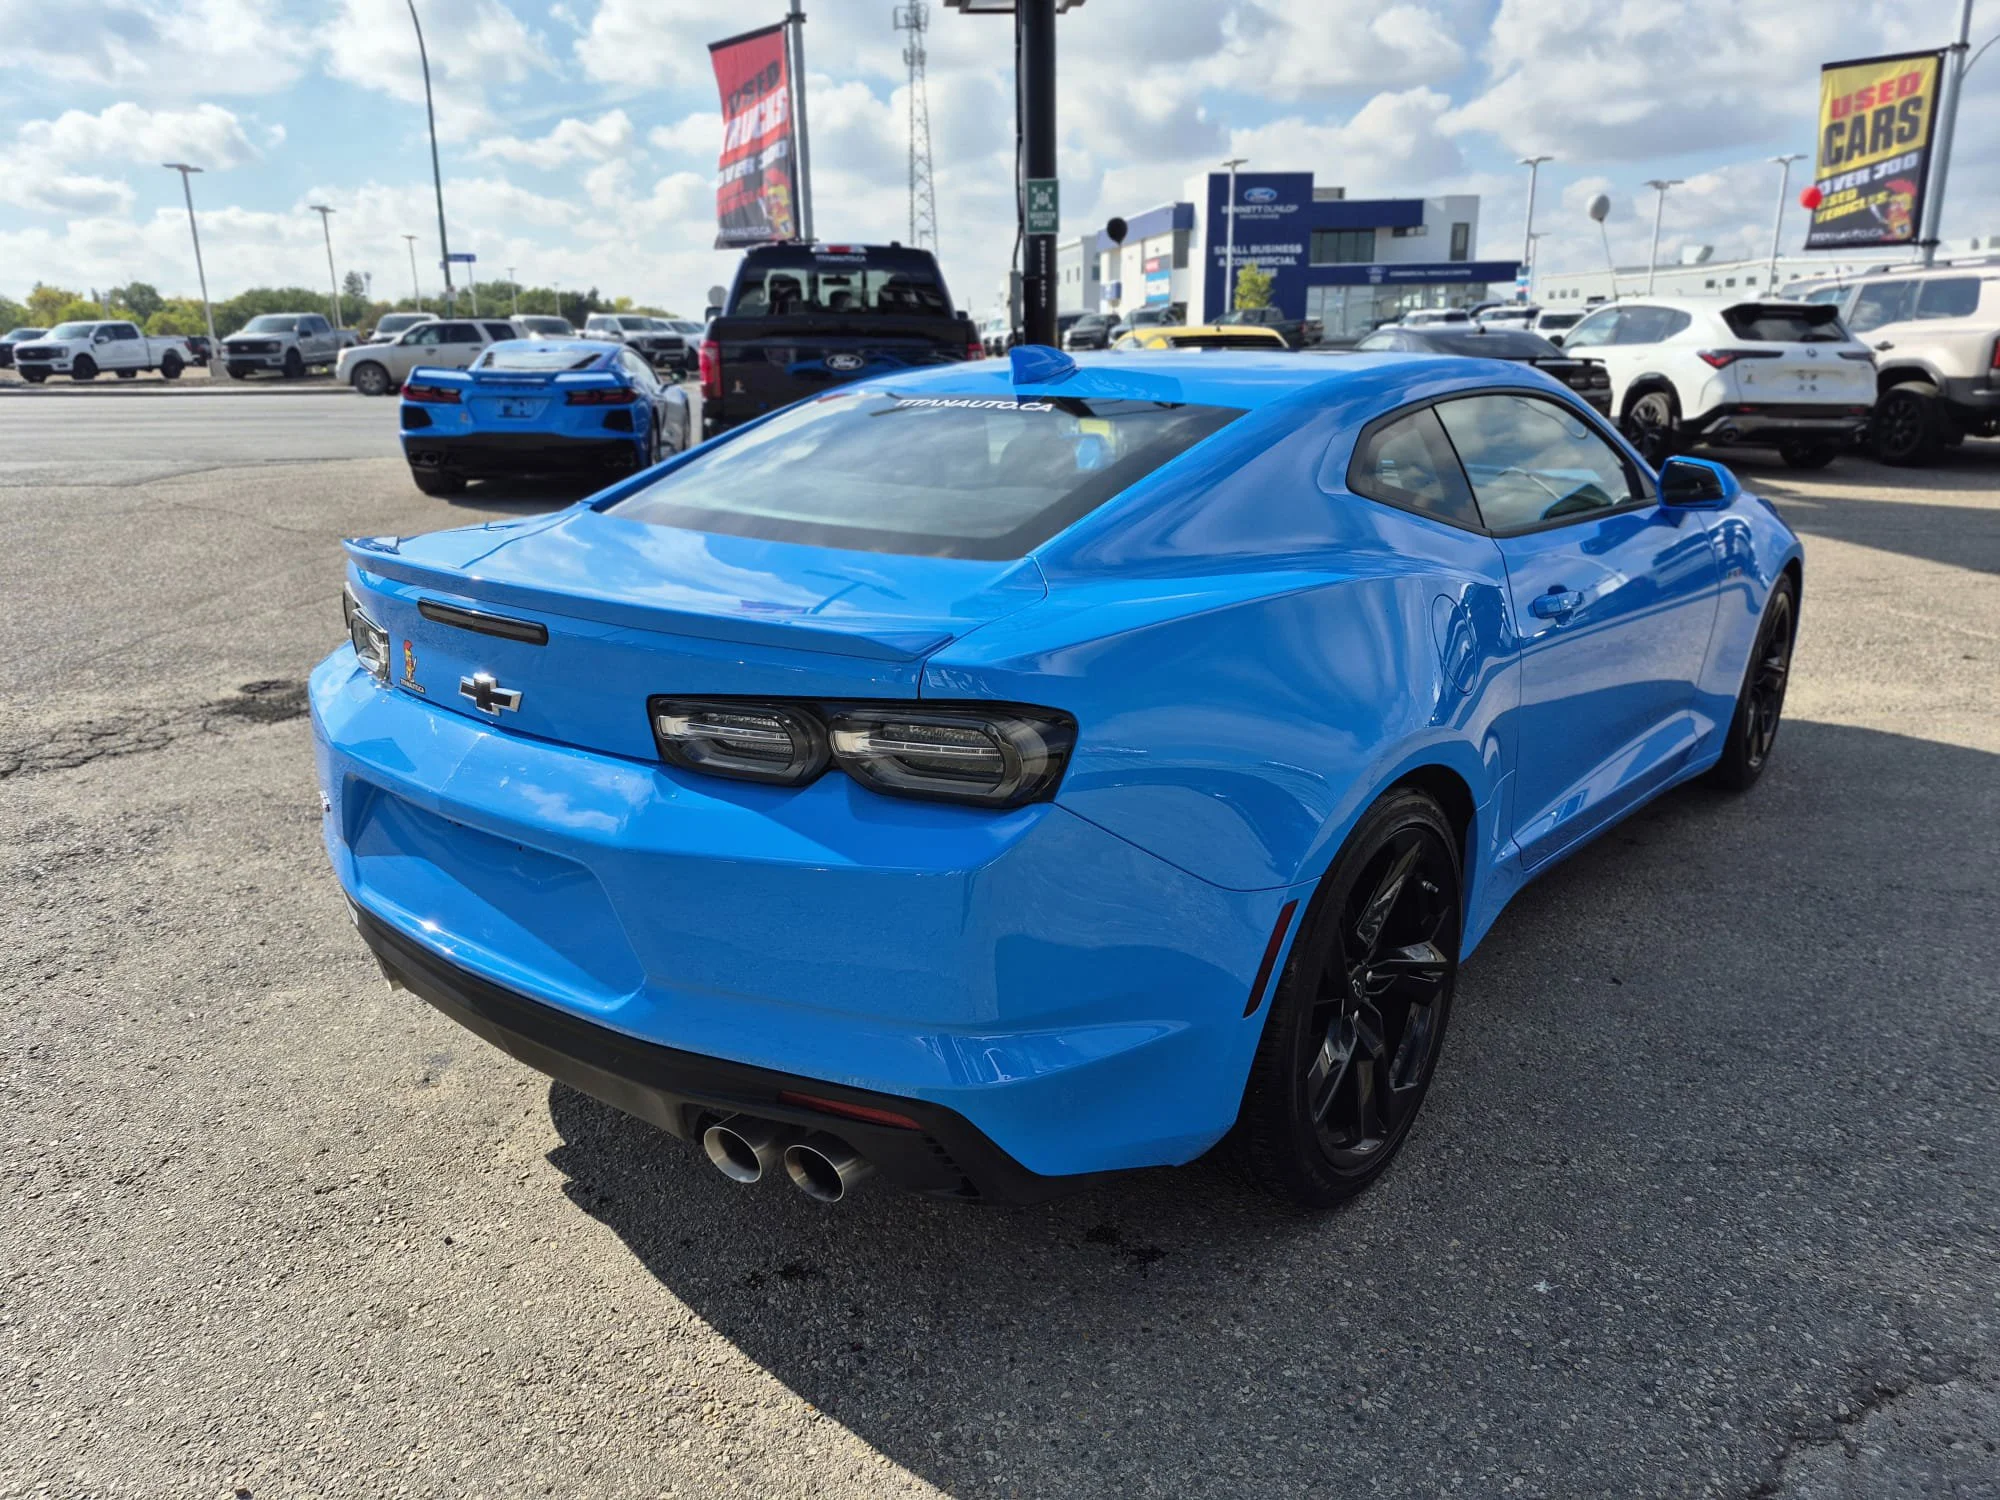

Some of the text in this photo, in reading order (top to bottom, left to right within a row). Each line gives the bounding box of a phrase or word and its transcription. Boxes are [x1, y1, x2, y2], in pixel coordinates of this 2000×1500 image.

[727, 60, 781, 117] USED
[1830, 71, 1921, 120] USED
[1822, 96, 1923, 168] CARS
[1818, 152, 1919, 196] OVER 300
[1250, 244, 1302, 254] BUSINESS
[832, 355, 858, 369] Ford
[896, 398, 1055, 413] TITANAUTO.CA
